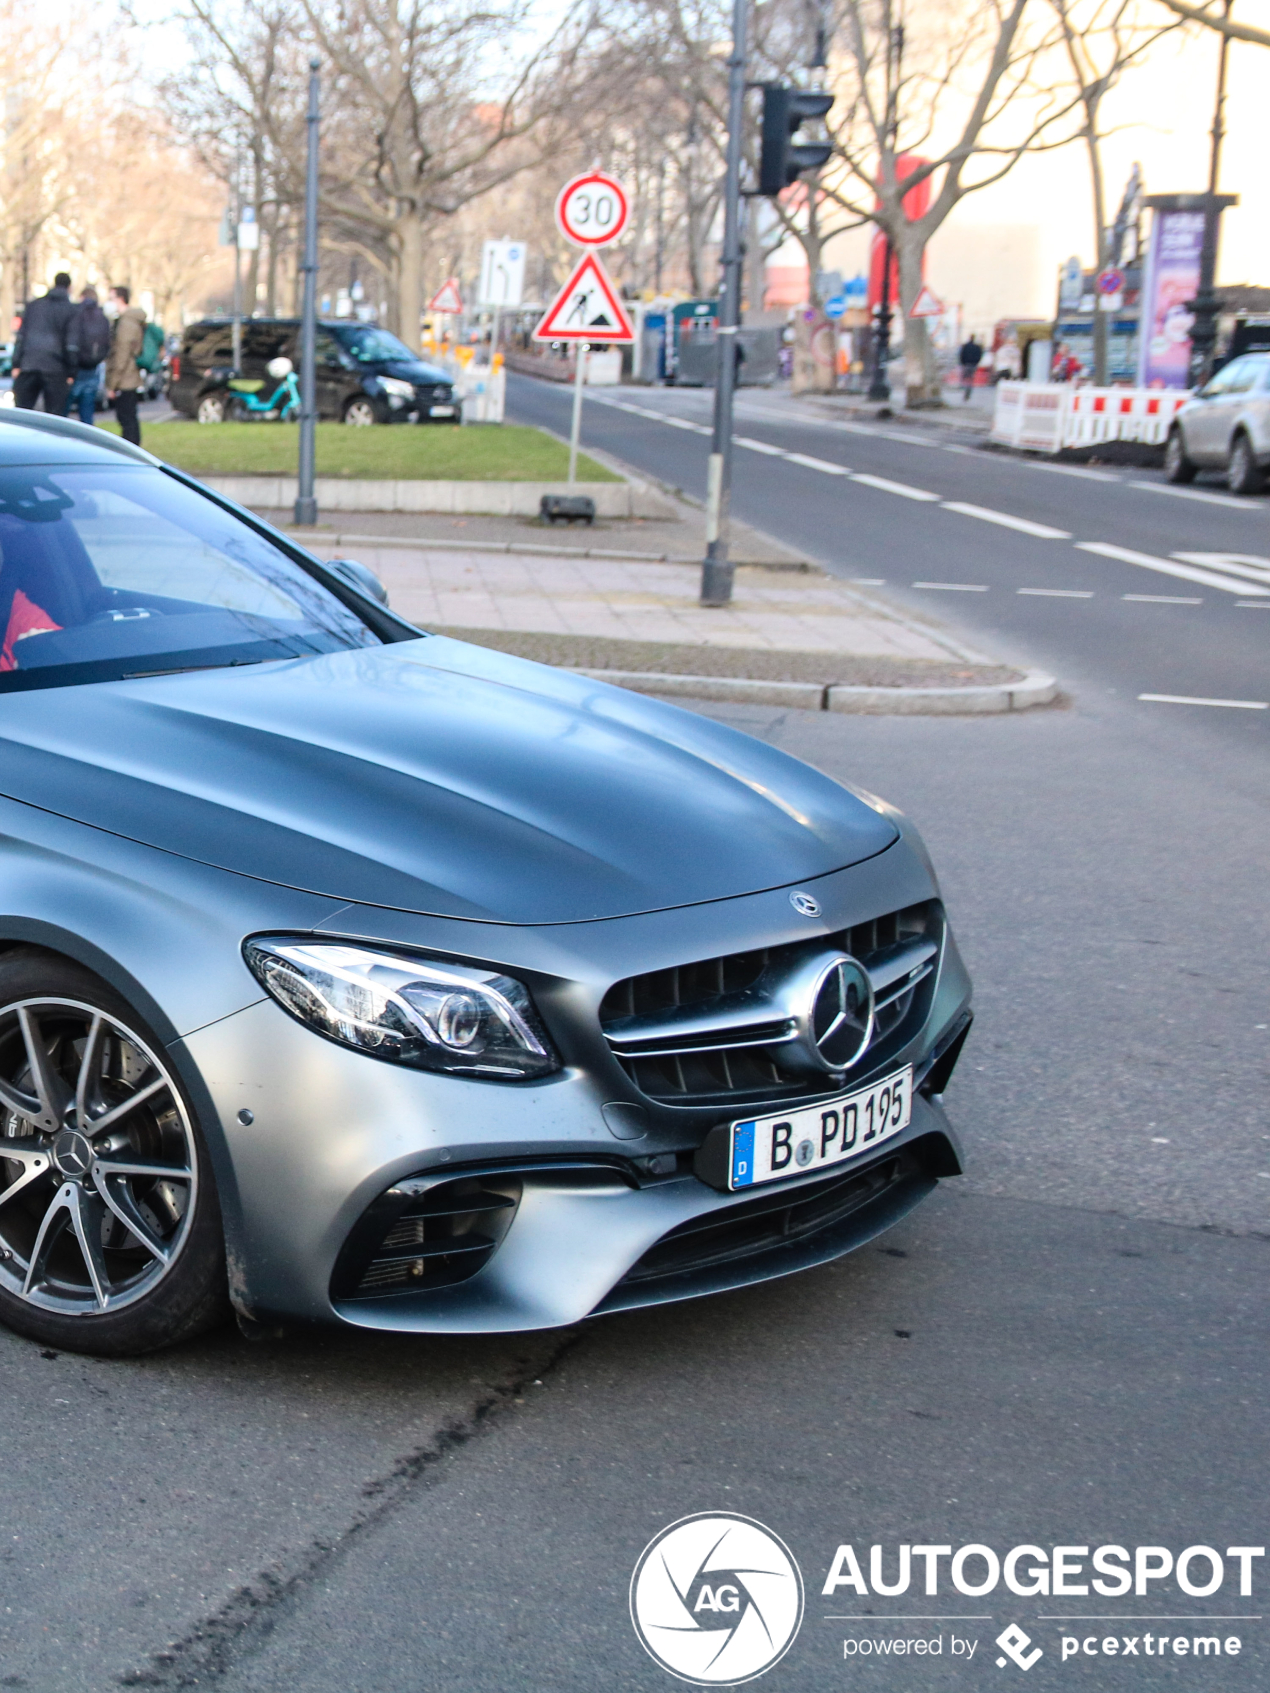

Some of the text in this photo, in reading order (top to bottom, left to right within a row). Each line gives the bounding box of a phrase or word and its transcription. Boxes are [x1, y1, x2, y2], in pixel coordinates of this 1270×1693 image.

[574, 194, 612, 226] 30
[771, 1079, 903, 1171] B PD 195
[738, 1161, 747, 1175] D
